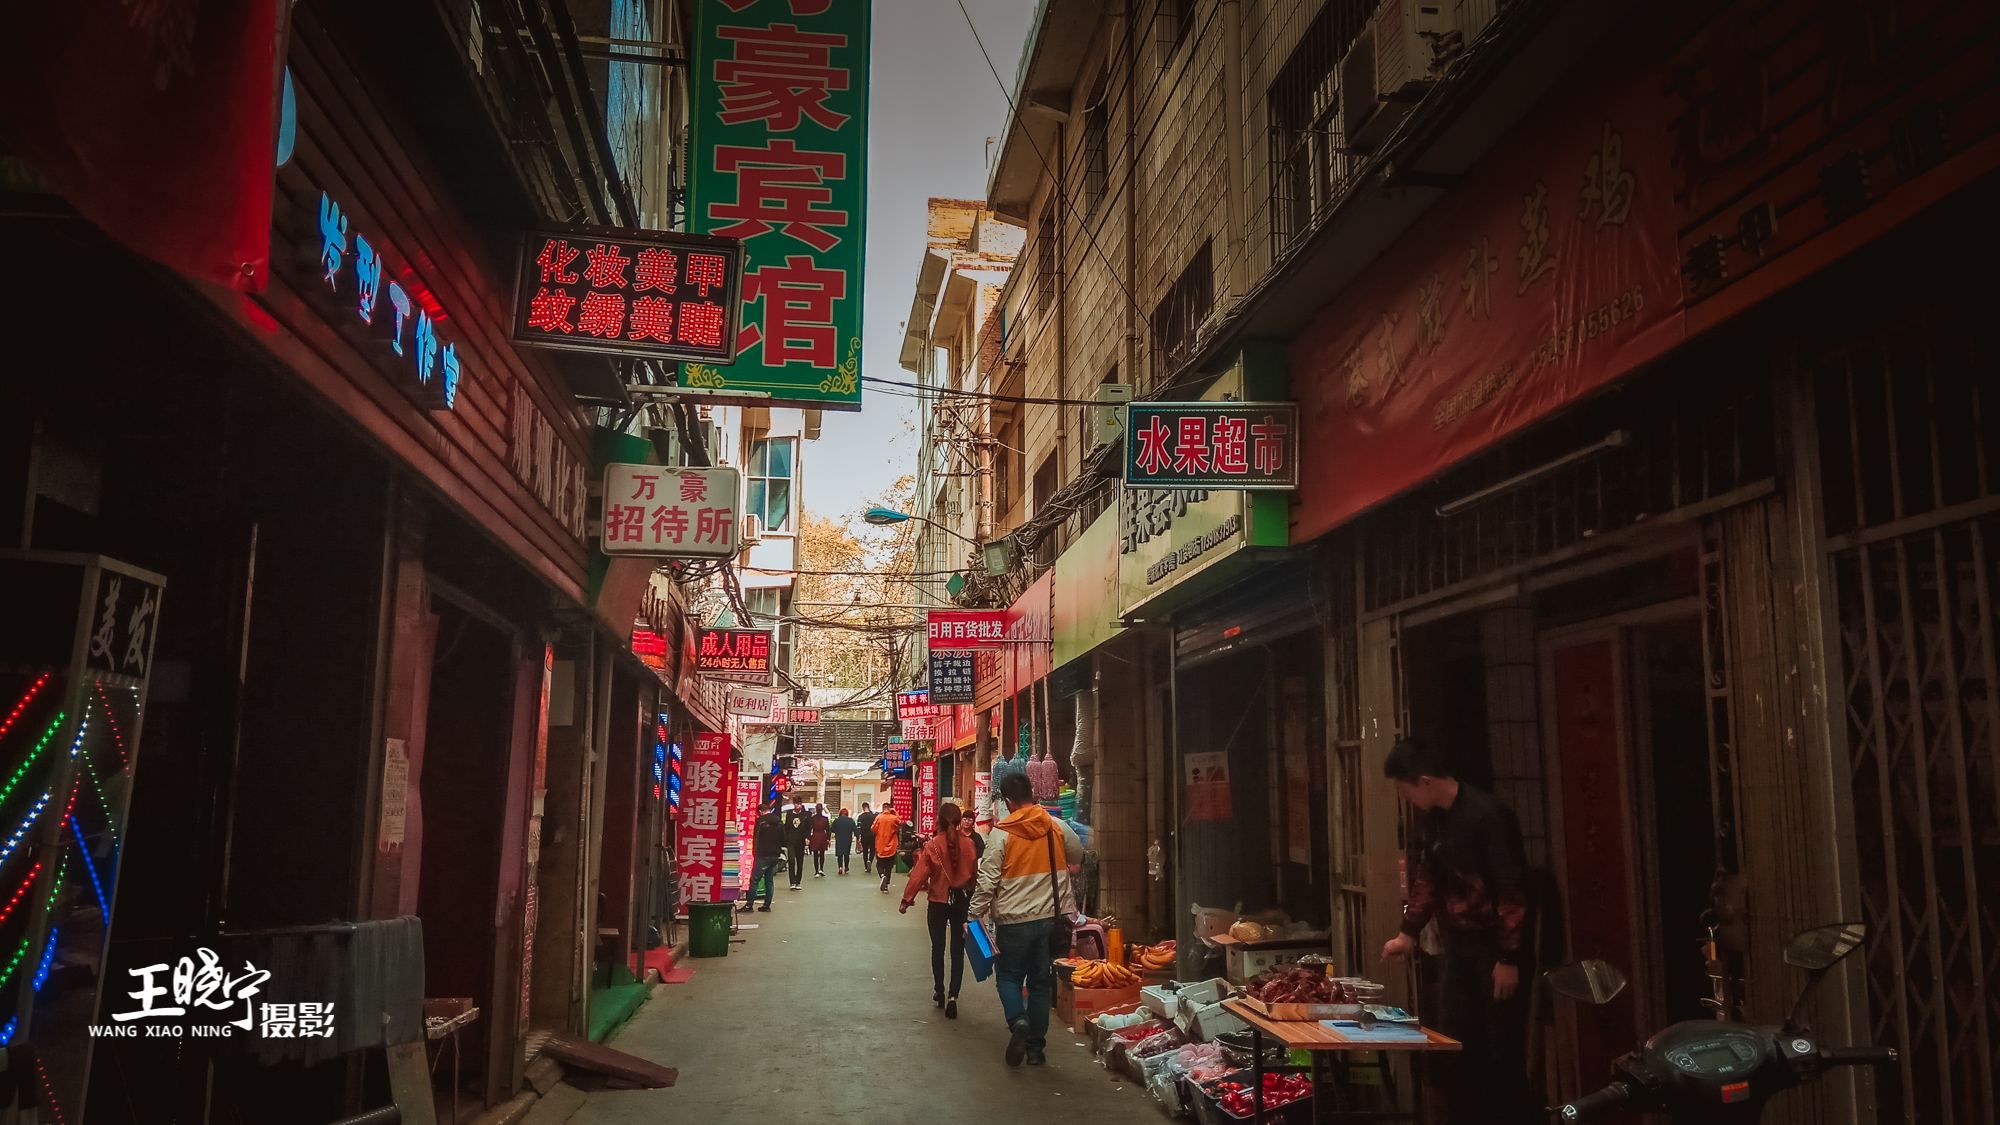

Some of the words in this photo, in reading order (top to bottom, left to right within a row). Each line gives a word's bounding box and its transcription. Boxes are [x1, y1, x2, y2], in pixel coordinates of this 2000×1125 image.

[708, 0, 851, 368] 豪宾馆
[535, 239, 726, 297] 化妆美甲
[317, 190, 461, 410] 发型工作室
[527, 286, 724, 347] 纹绣美睫
[1135, 414, 1288, 476] 水果超市
[631, 474, 708, 502] 万豪
[607, 503, 733, 545] 招待所
[91, 576, 155, 674] 美发
[700, 631, 768, 658] 成人用品
[928, 620, 1004, 640] 日用百货批发
[699, 656, 767, 670] 24小时无人售货
[733, 696, 769, 711] 便利店
[898, 694, 929, 706] 过桥米
[904, 725, 937, 740] 招待所
[677, 760, 722, 906] 骏通宾馆
